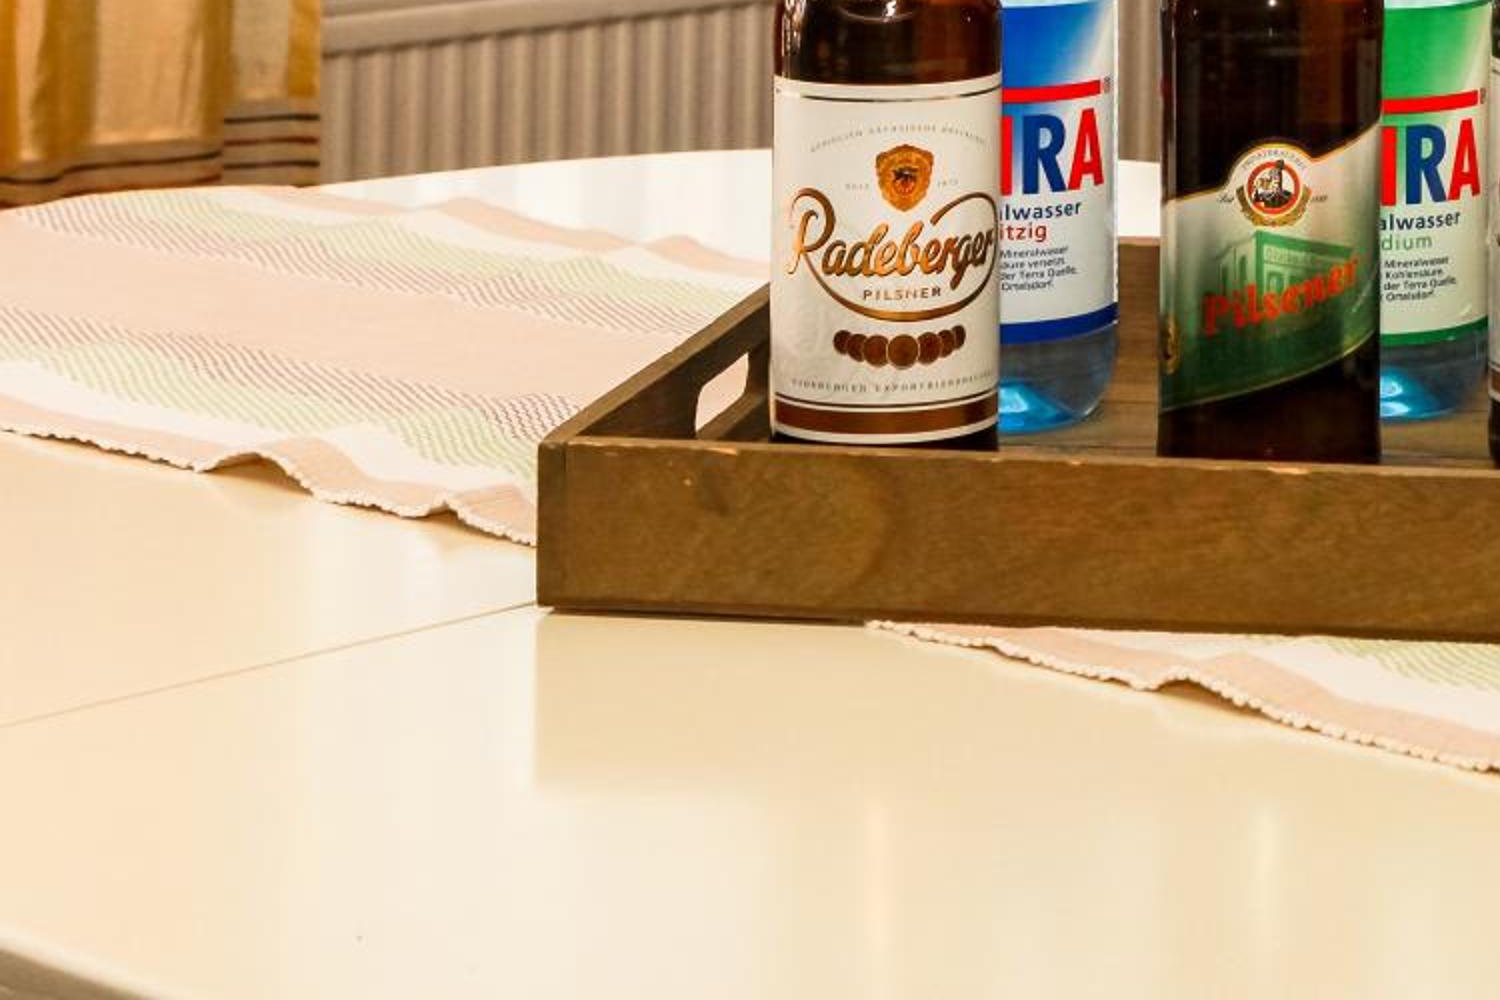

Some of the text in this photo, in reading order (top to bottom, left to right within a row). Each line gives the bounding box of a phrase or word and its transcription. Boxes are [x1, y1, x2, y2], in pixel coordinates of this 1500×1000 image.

[1000, 202, 1082, 221] lwasser
[788, 187, 997, 291] Radeberger
[1381, 234, 1433, 251] dium
[863, 286, 942, 301] PILSNER
